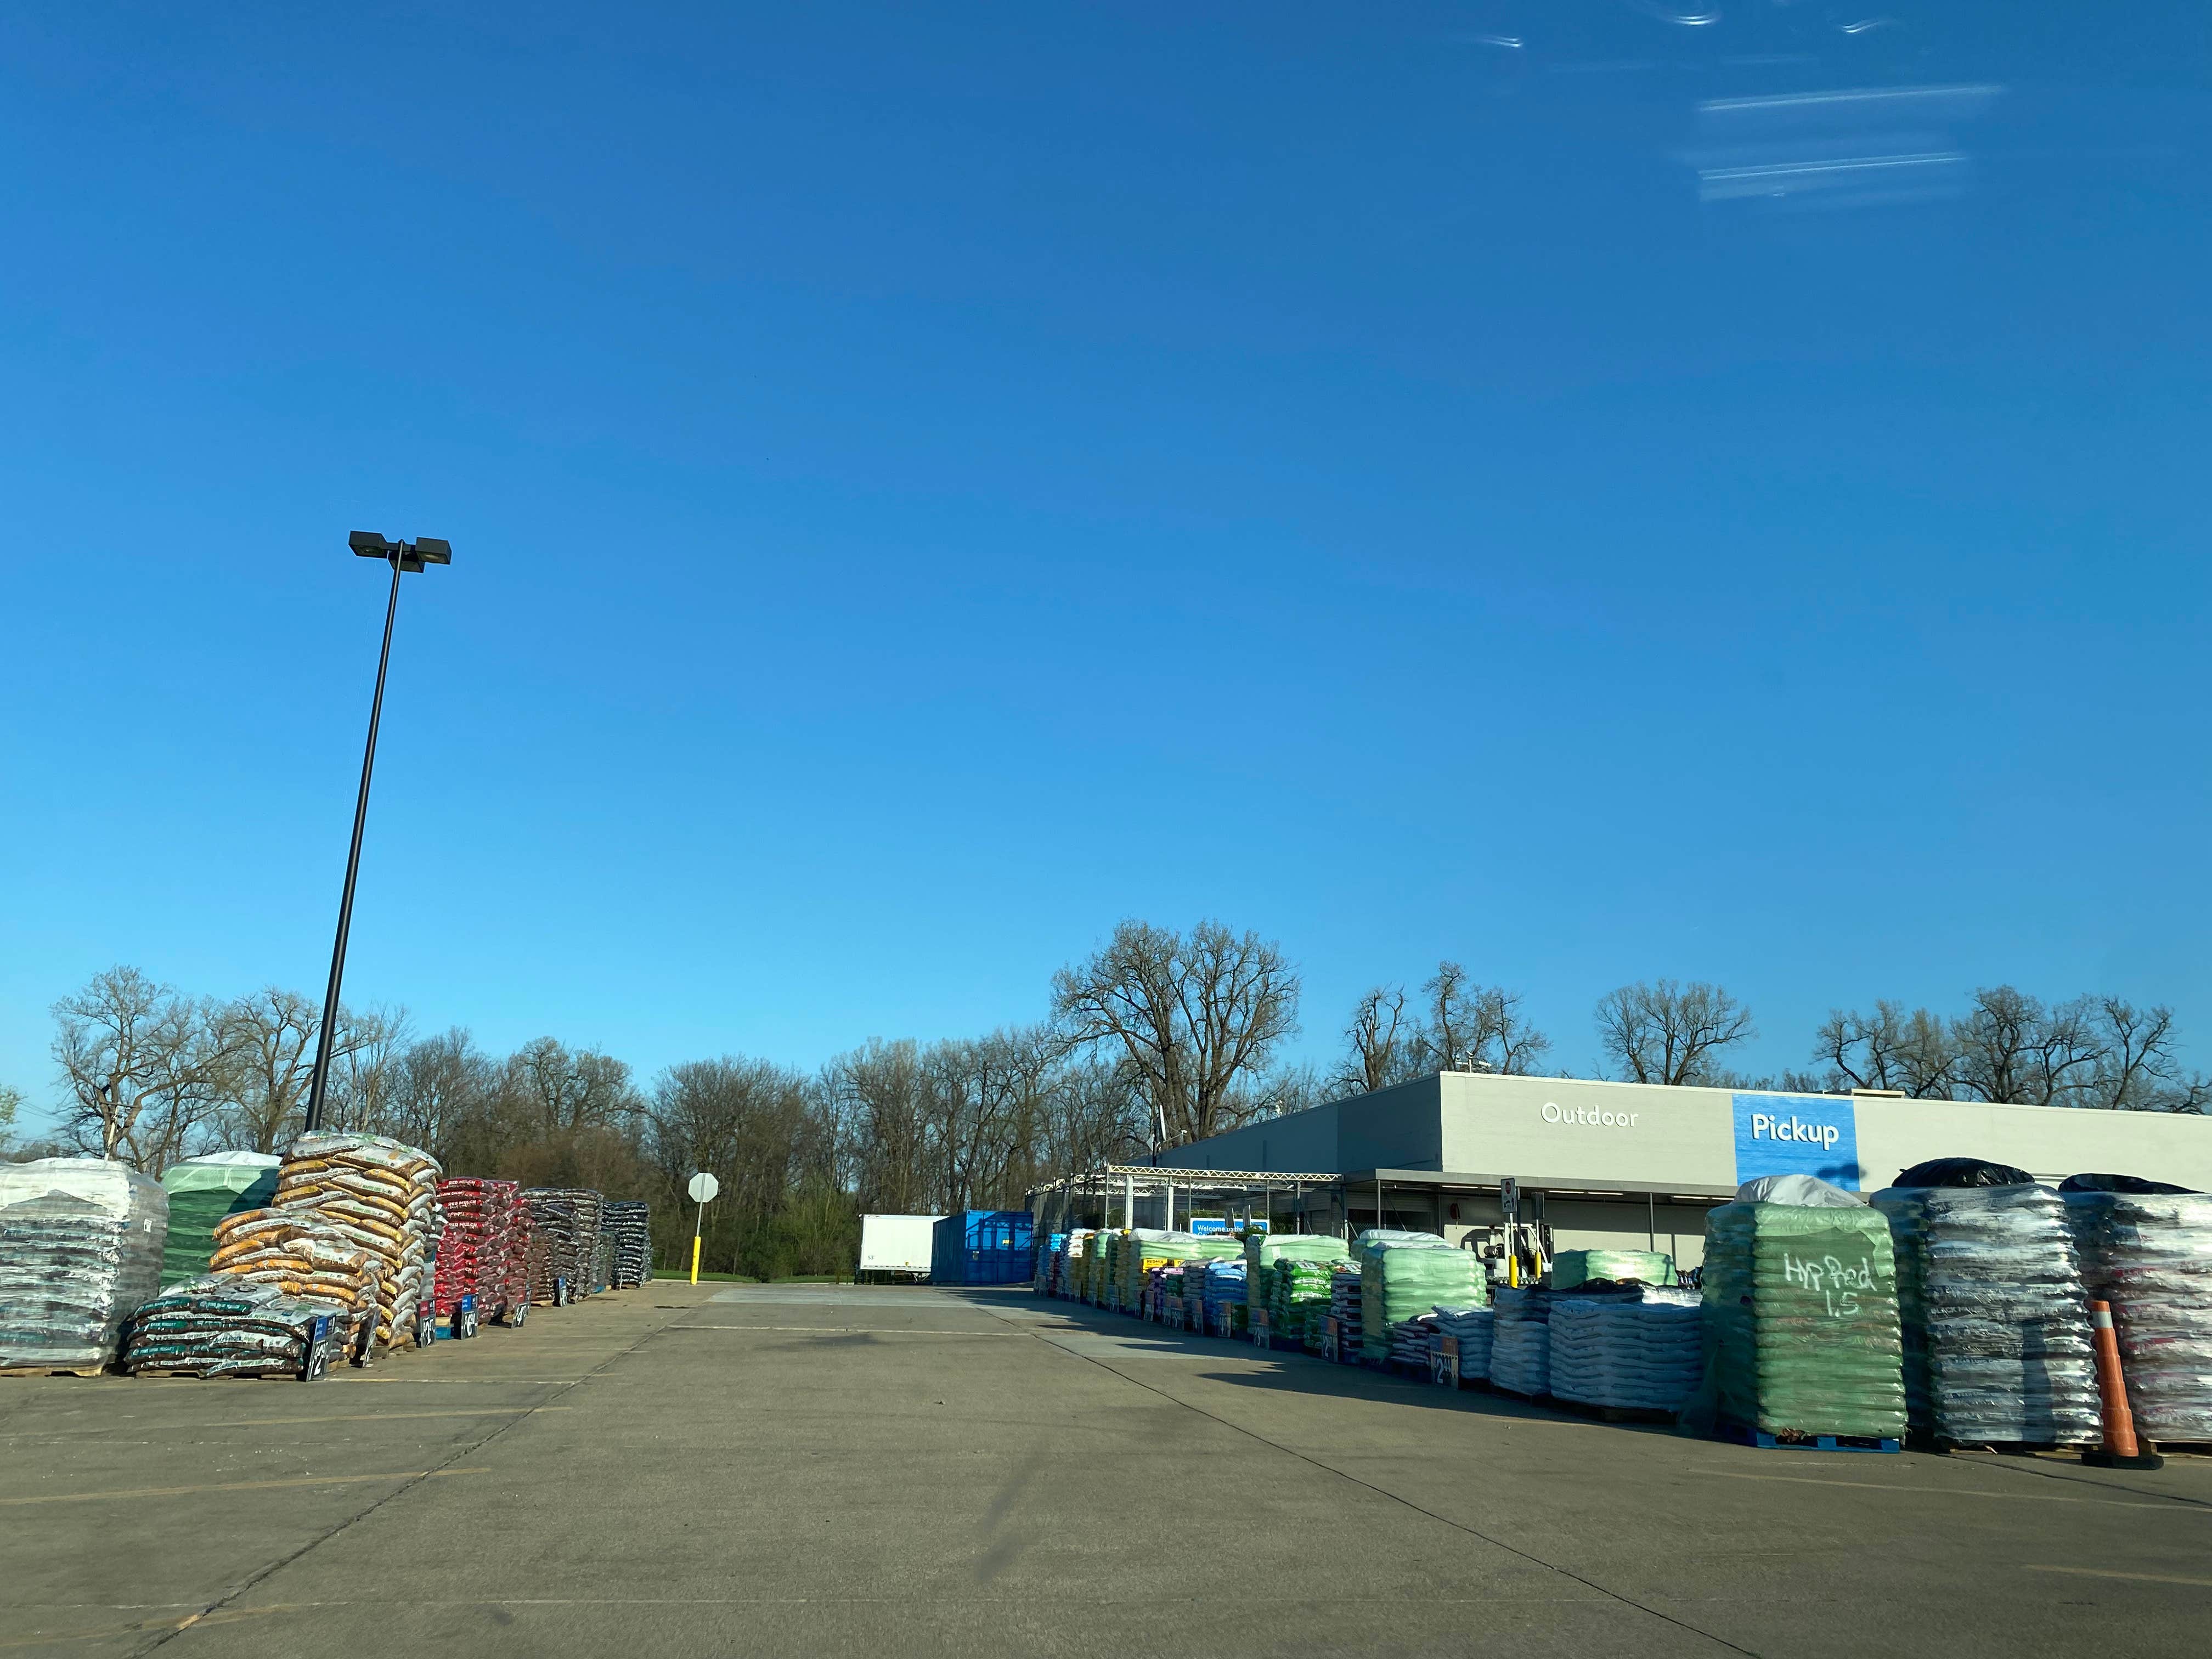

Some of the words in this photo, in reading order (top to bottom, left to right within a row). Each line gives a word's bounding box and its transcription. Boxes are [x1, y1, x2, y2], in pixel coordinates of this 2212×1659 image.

[1540, 1102, 1639, 1127] Outdoor
[1751, 1113, 1839, 1151] Pickup
[1826, 1289, 1859, 1317] 1.5
